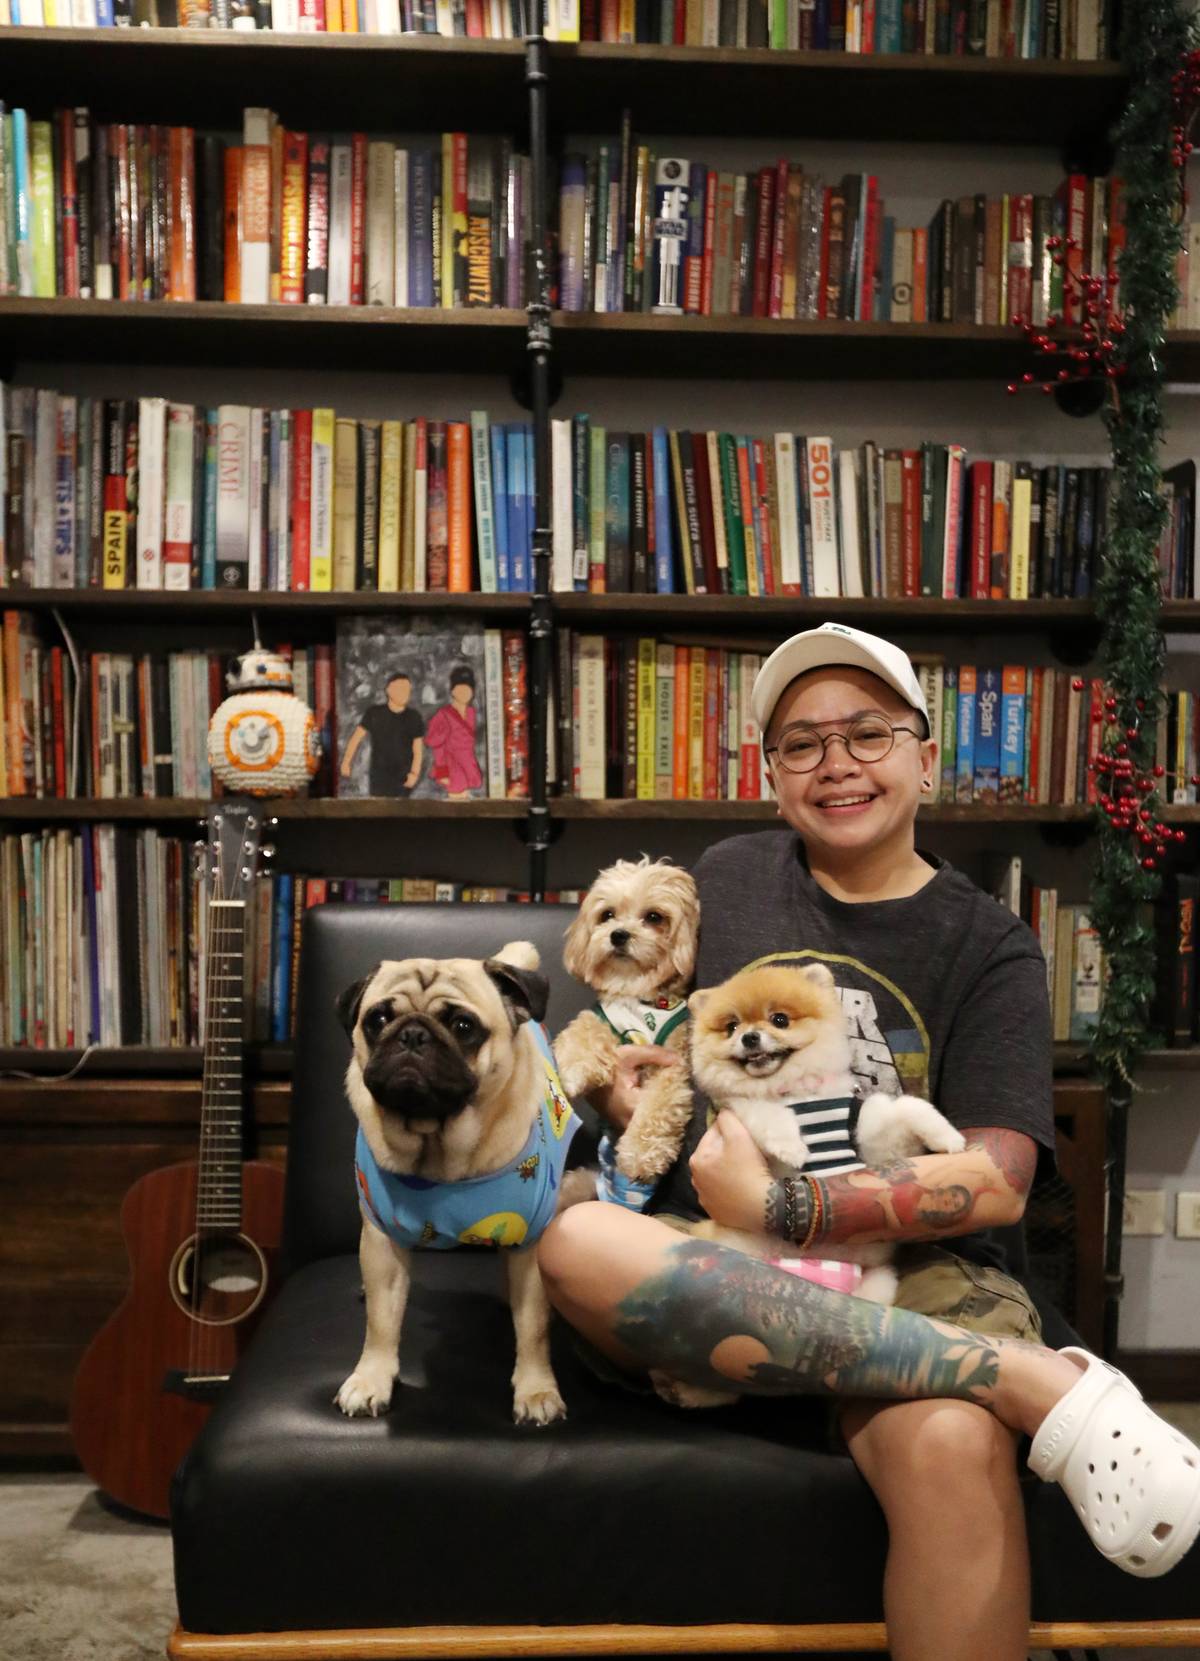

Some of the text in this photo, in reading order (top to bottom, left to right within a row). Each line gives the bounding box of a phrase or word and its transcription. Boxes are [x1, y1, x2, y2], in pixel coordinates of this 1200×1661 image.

[468, 217, 491, 303] AUSCHWITZ
[689, 256, 702, 308] AUDIENCE
[220, 422, 240, 501] CRIME
[684, 468, 697, 504] kama
[810, 444, 831, 498] 501
[56, 519, 72, 555] TIPS
[108, 515, 121, 576] SPAIN
[688, 506, 701, 542] sutra
[660, 682, 670, 767] HOUSE EXILE
[960, 695, 972, 746] Vietnam
[979, 691, 997, 737] Spain
[1004, 697, 1023, 754] Turkey
